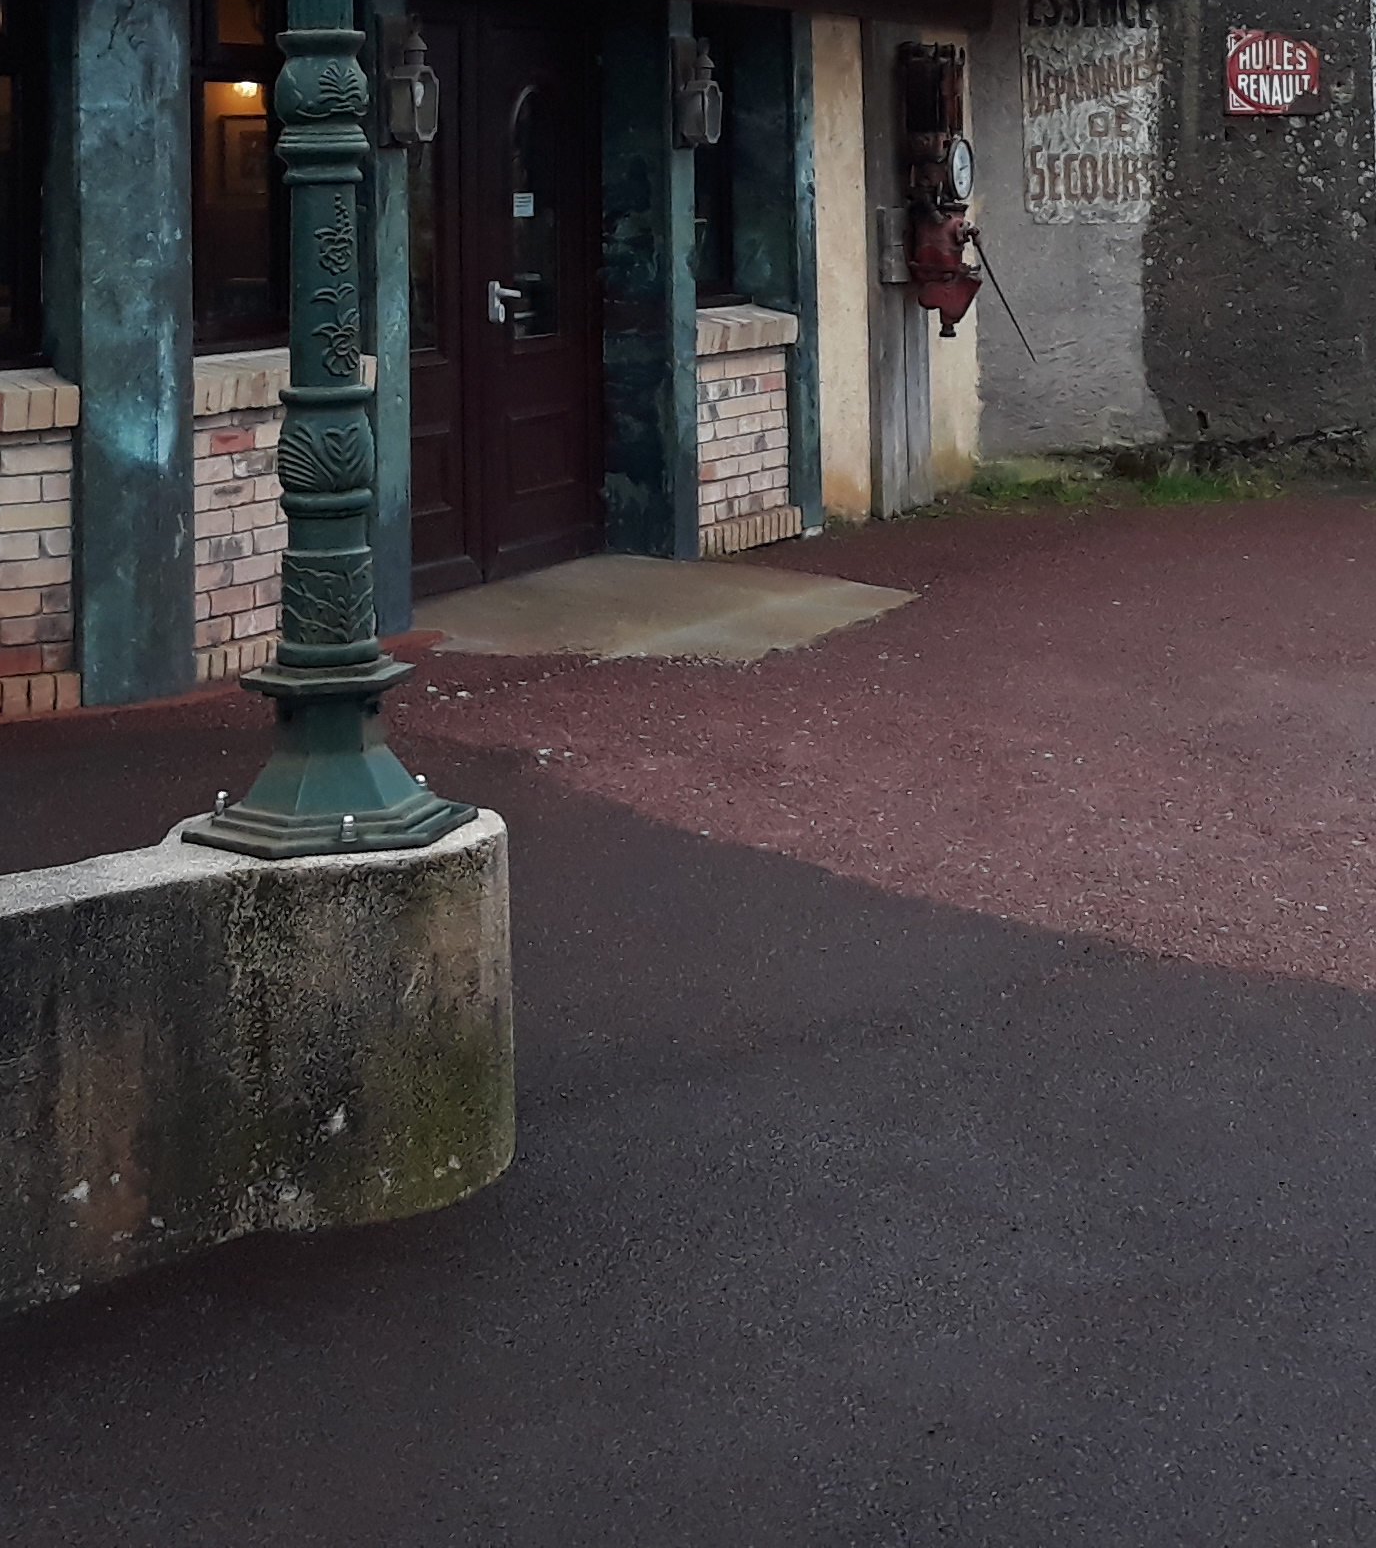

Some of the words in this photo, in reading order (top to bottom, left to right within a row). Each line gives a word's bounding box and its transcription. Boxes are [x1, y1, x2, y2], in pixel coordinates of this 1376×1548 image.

[1239, 39, 1307, 70] HUILES
[1238, 74, 1311, 105] RENAULT
[1089, 105, 1133, 138] DE
